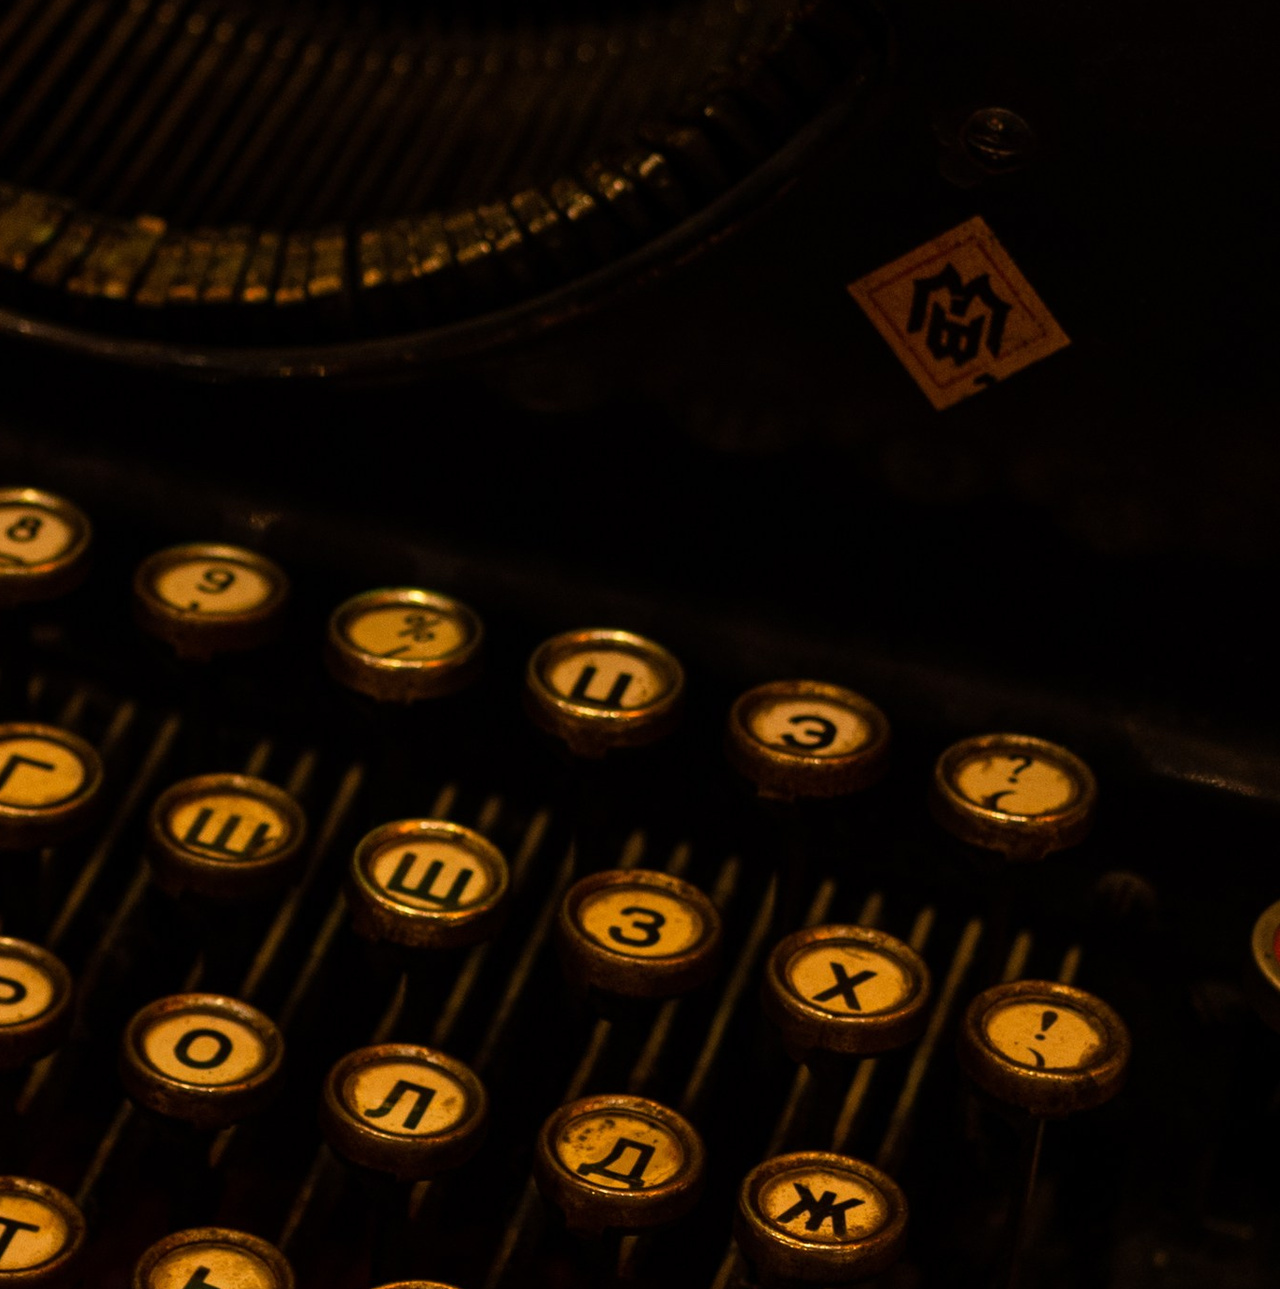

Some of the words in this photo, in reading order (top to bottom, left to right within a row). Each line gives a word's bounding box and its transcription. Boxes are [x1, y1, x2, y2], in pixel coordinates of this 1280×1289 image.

[5, 515, 42, 543] 8
[197, 567, 234, 594] 9
[1004, 754, 1032, 784] ?
[810, 961, 877, 1012] Х
[1031, 1010, 1058, 1041] !
[173, 1027, 234, 1070] О
[362, 1079, 437, 1131] Л
[577, 1136, 657, 1192] Д
[774, 1181, 868, 1240] Ж
